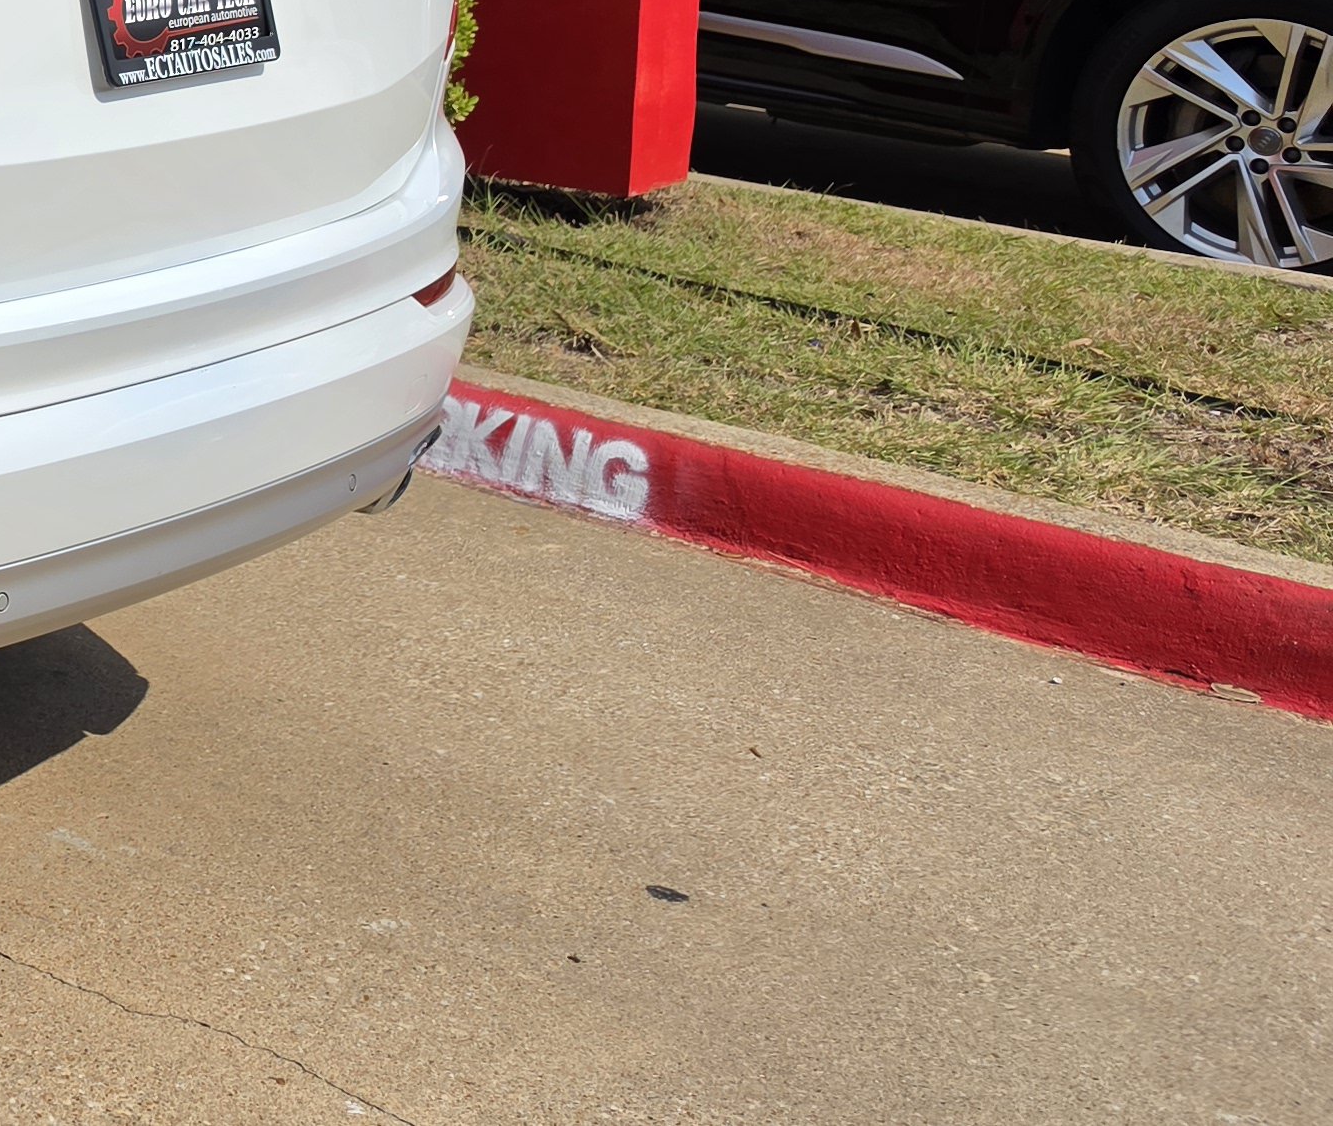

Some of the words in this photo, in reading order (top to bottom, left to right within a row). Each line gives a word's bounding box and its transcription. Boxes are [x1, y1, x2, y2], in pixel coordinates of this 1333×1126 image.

[168, 14, 210, 29] european
[211, 6, 258, 22] automotive
[170, 27, 259, 52] 817-404-4033
[119, 41, 277, 85] www.ECTAUTOSALES.com
